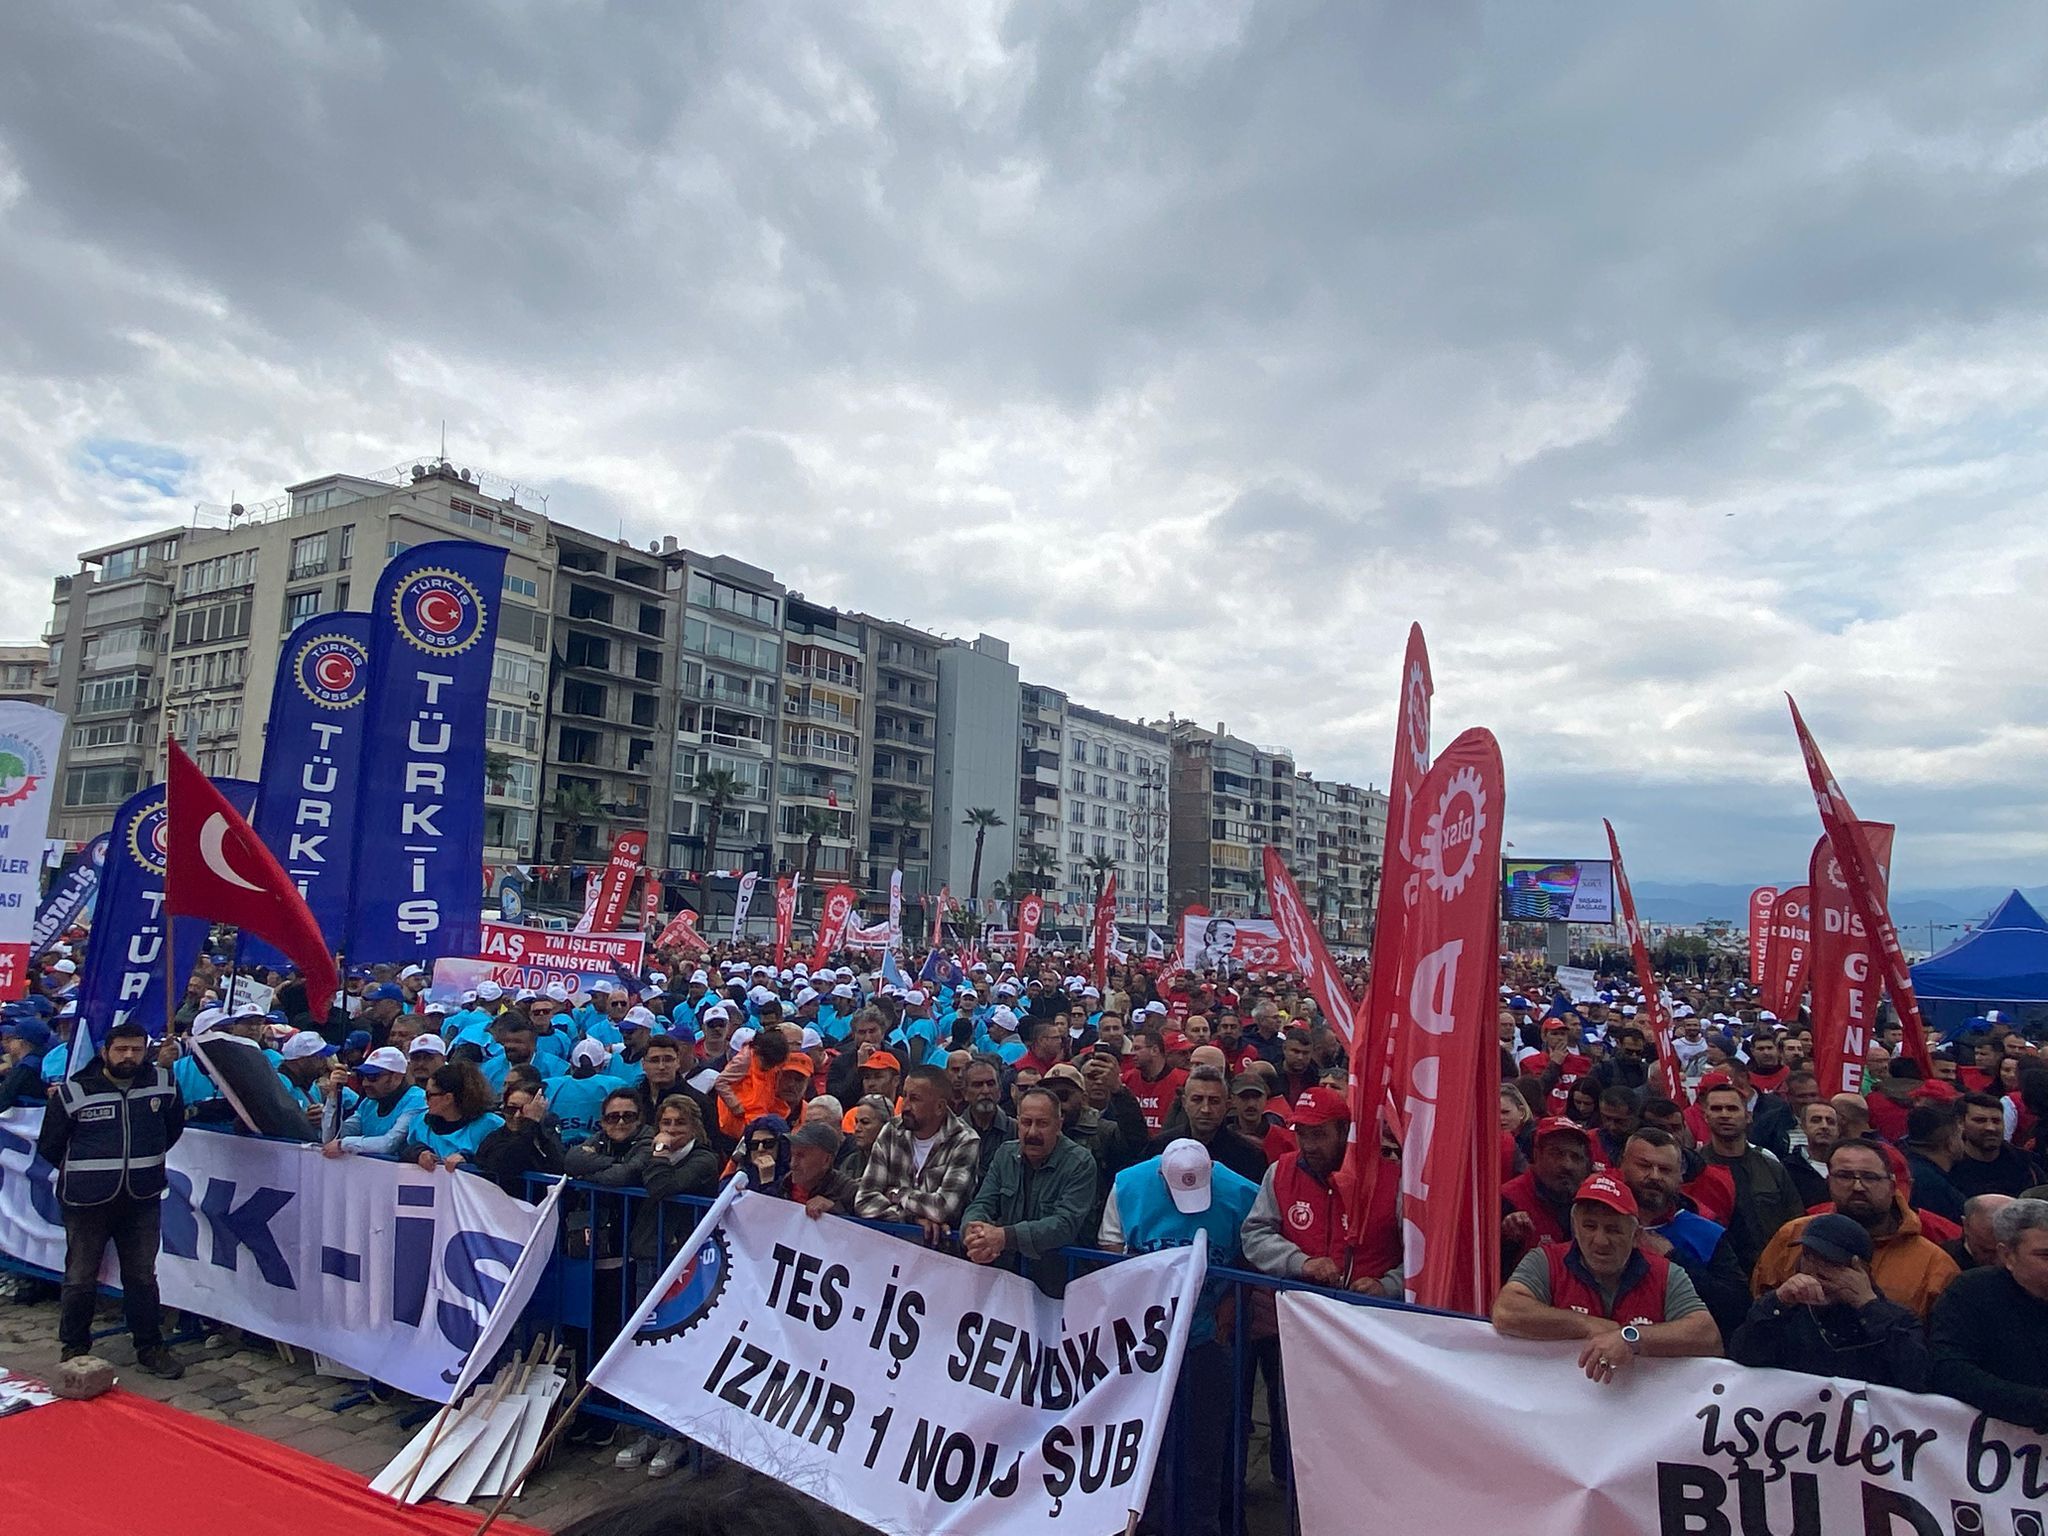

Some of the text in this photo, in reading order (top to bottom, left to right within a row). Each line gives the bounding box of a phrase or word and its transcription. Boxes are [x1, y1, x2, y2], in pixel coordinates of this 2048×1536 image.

[417, 628, 458, 647] 1952
[314, 686, 349, 701] 1952
[288, 722, 343, 901] TÜRK-İ
[397, 671, 454, 945] TÜRK-İŞ
[612, 856, 638, 870] DİSK
[600, 871, 627, 931] GENEL-
[1824, 904, 1867, 938] DİS
[545, 936, 627, 956] TM İŞLETME
[491, 966, 581, 995] KADRO
[1842, 952, 1870, 1094] GENE
[703, 1320, 856, 1454] İZMİR
[863, 1405, 894, 1470] 1
[1697, 1383, 1938, 1483] işçiler
